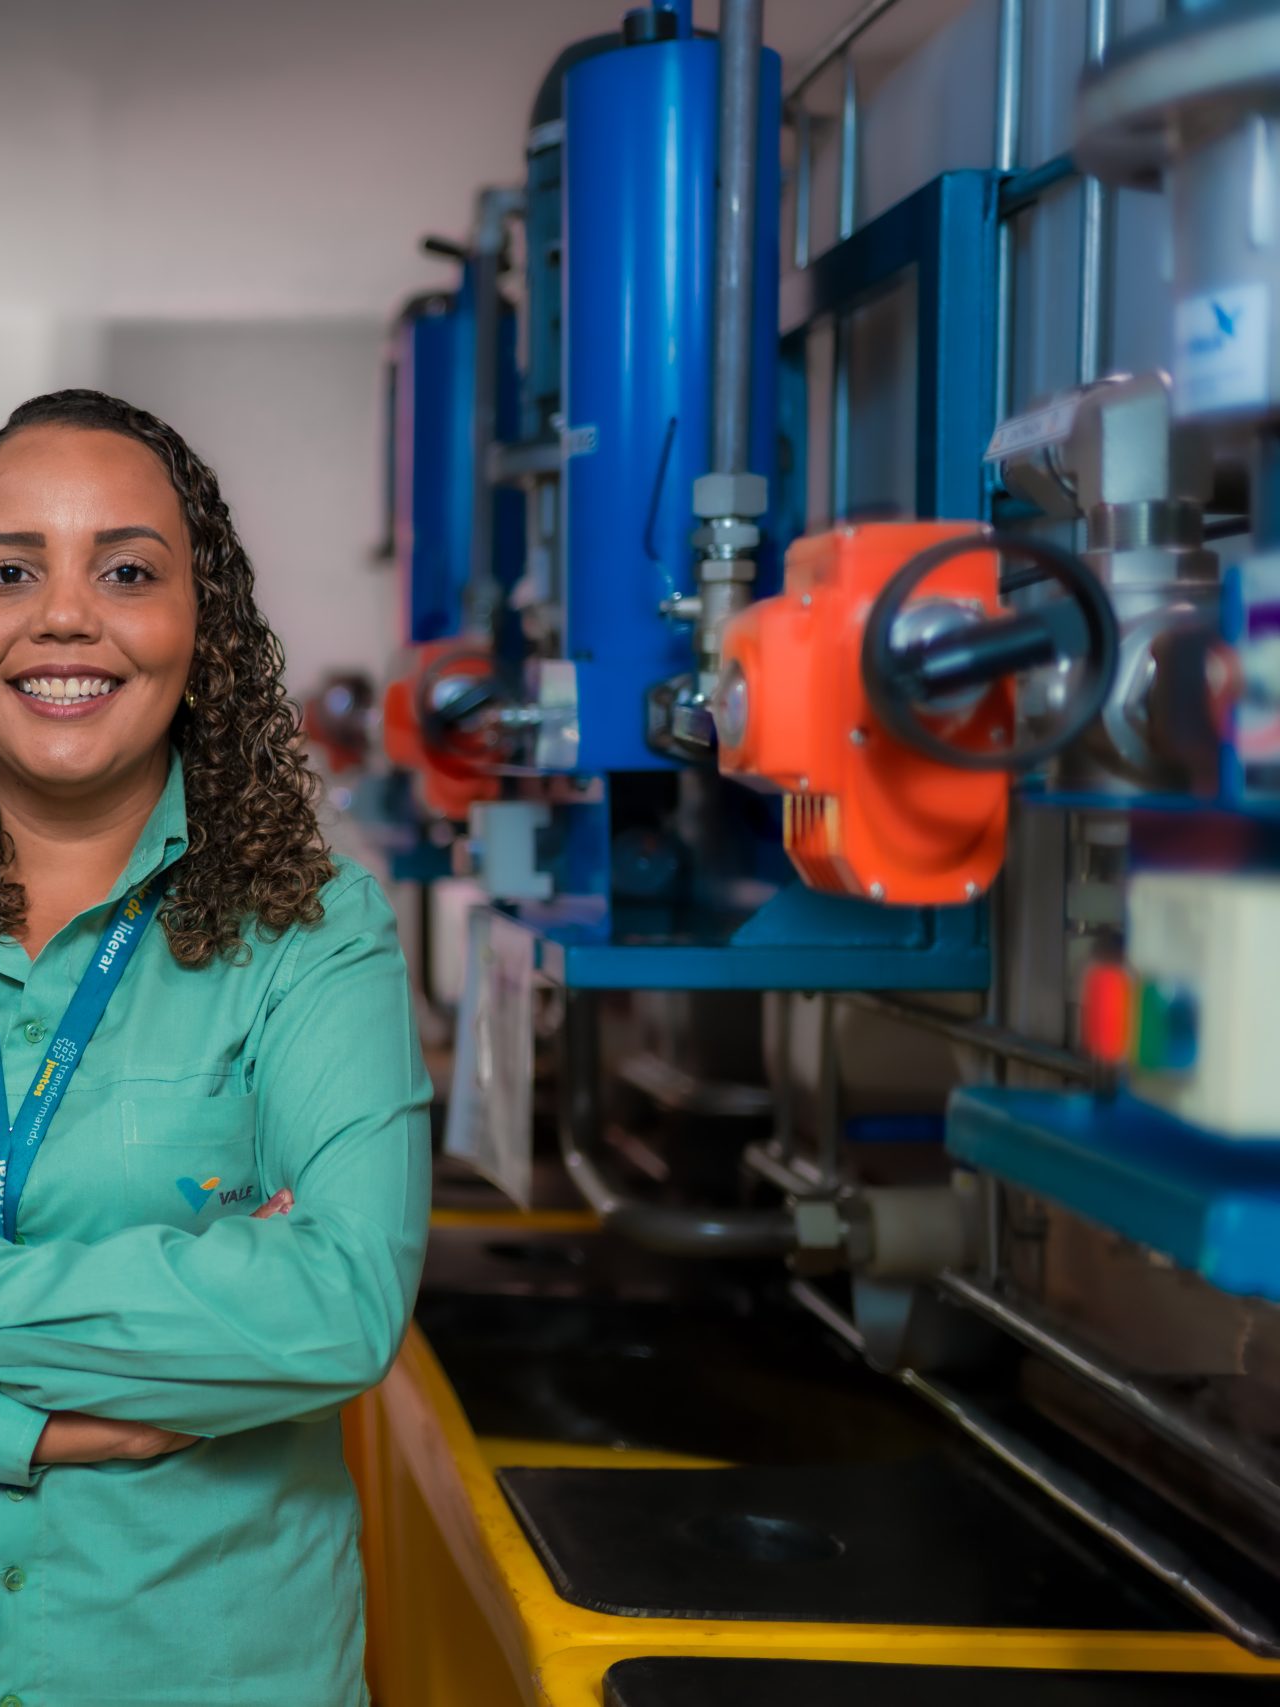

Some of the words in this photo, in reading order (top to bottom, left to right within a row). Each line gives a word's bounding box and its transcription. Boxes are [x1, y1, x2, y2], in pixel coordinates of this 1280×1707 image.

[98, 920, 135, 974] liderar
[33, 1058, 60, 1097] juntos
[219, 1185, 253, 1206] VALE
